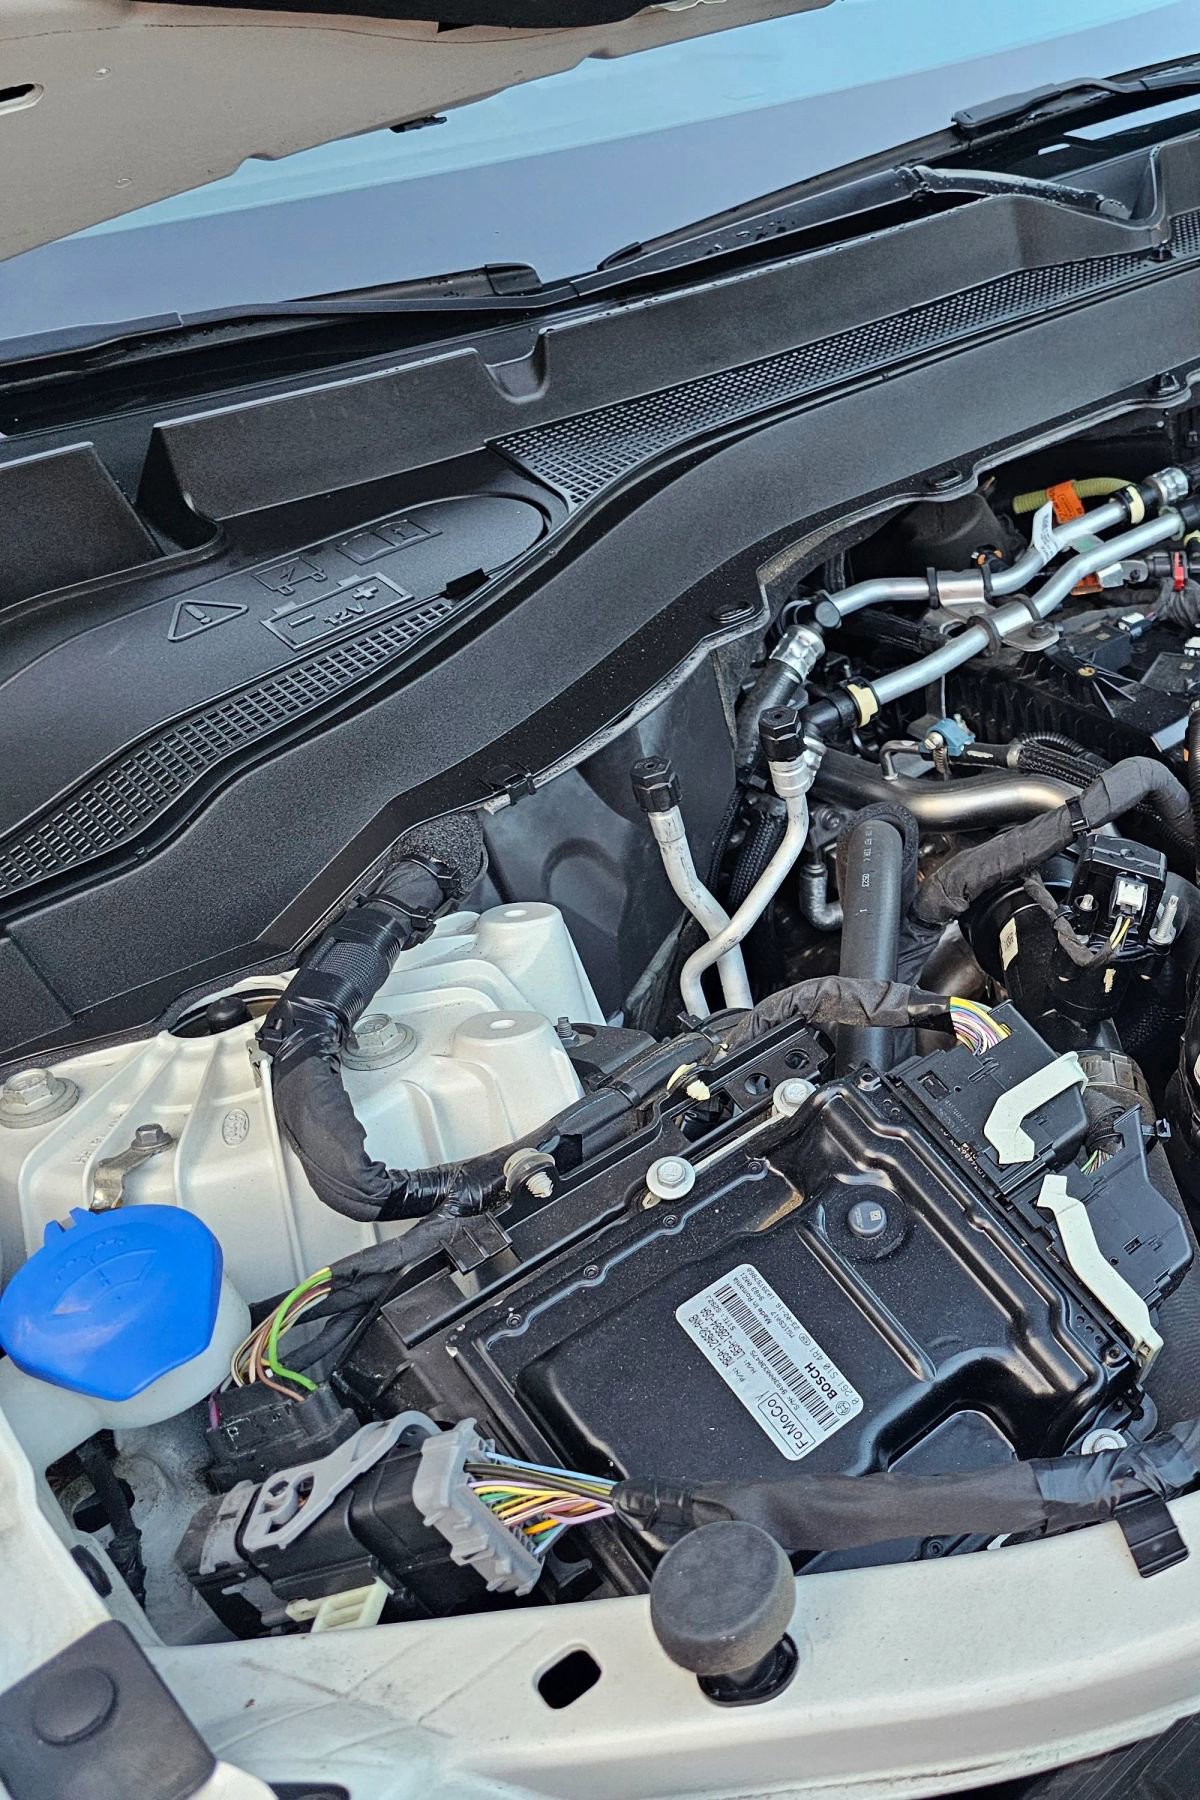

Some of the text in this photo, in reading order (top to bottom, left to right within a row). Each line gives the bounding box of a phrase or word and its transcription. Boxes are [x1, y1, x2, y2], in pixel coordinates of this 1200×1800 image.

[732, 1277, 753, 1301] Romania
[757, 1307, 771, 1323] Made
[804, 1362, 837, 1399] BOSCH
[838, 1381, 852, 1395] 261
[764, 1397, 808, 1449] FoMoCo
